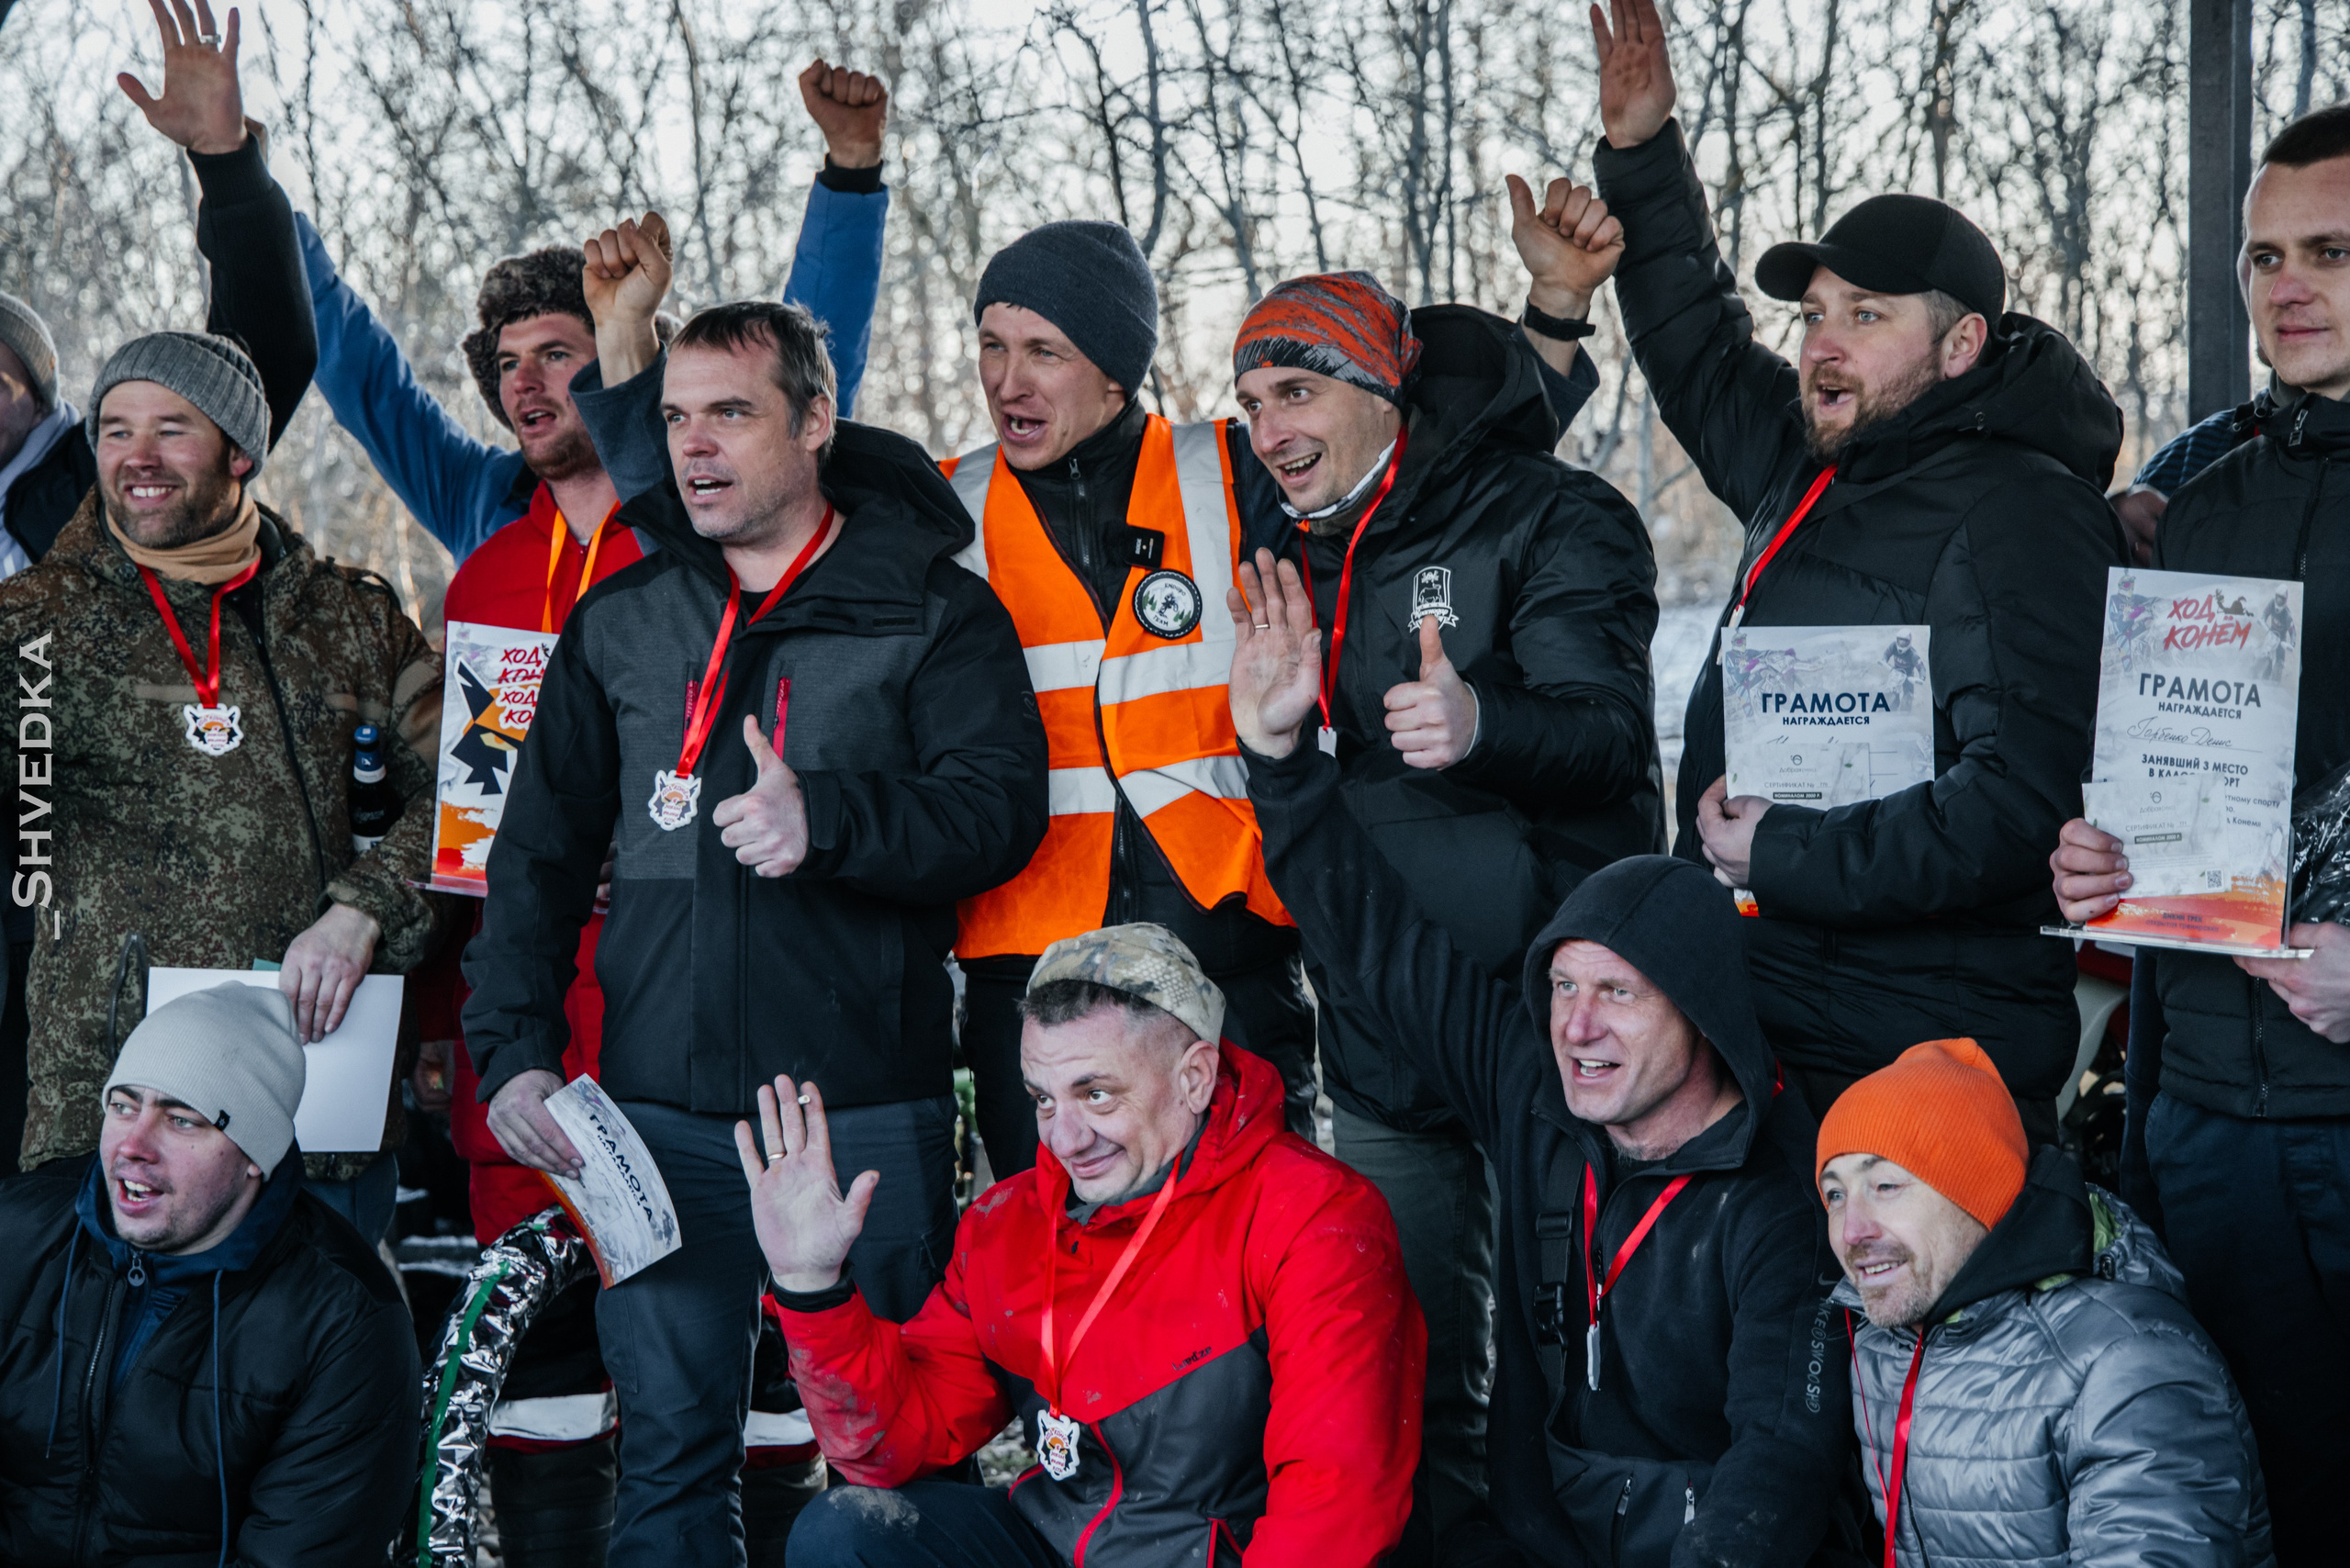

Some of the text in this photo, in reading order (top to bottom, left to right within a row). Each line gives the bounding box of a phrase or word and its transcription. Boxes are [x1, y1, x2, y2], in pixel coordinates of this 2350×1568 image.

[1165, 583, 1186, 596] ENDURO
[2167, 594, 2216, 621] ХОД
[1153, 615, 1169, 626] TEAM
[2164, 615, 2253, 651] КОНЁМ
[499, 646, 543, 667] ХОД
[2139, 673, 2261, 708] ГРАМОТА
[1762, 692, 1891, 713] ГРАМОТА
[2158, 701, 2242, 720] НАГРАЖДАЕТСЯ
[1783, 716, 1870, 726] НАГРАЖДАЕТСЯ
[2142, 754, 2248, 775] ЗАНЯВШИЙ 3 МЕСТО
[2149, 767, 2154, 778] В
[2253, 798, 2280, 809] спорту
[2125, 822, 2165, 833] СЕРТИФИКАТ
[589, 1114, 653, 1223] ГРАМОТА
[598, 1135, 641, 1206] НАГРАЖДАЕТСЯ
